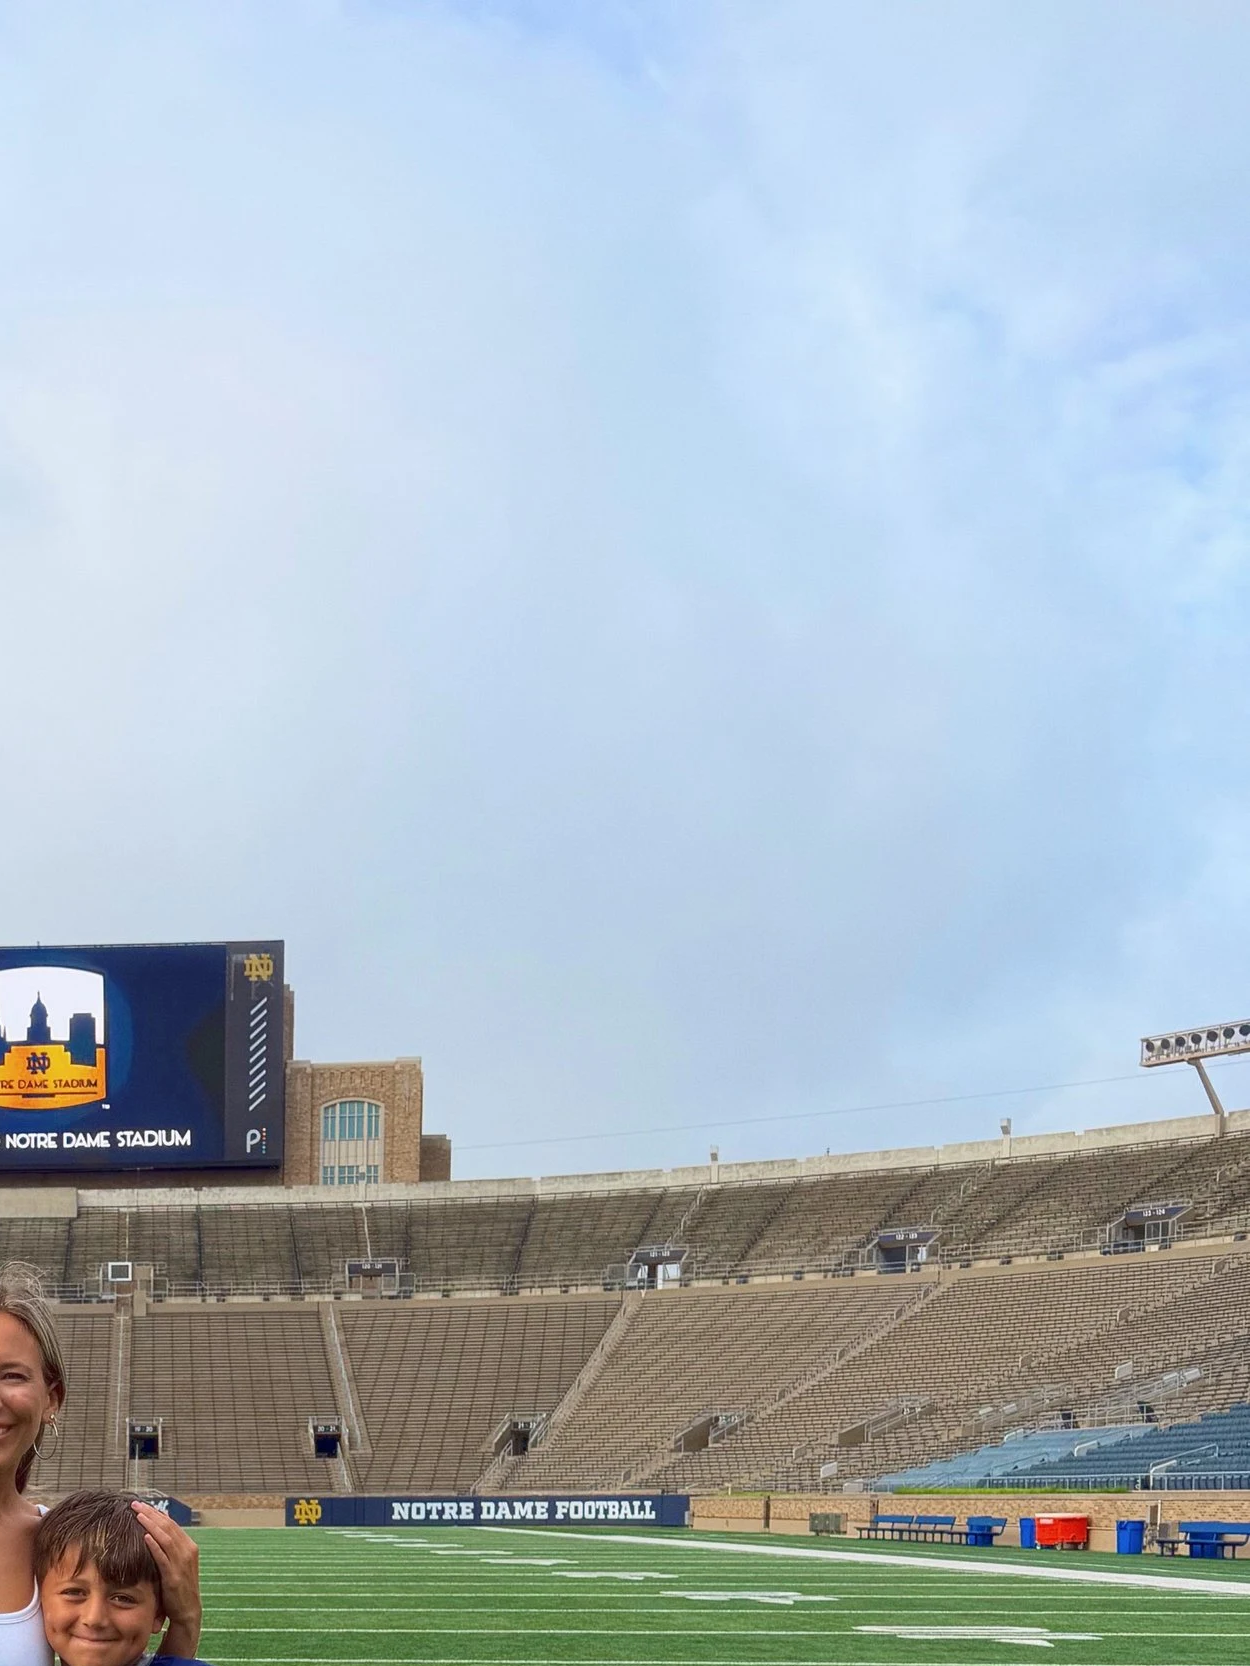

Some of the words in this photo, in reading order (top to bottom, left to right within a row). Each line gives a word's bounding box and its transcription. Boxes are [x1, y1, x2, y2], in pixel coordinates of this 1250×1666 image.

[17, 1079, 49, 1089] DAME
[53, 1078, 98, 1089] STADIUM
[5, 1131, 58, 1149] NOTRE
[62, 1131, 111, 1149] DAME
[116, 1129, 192, 1148] STADIUM
[391, 1502, 475, 1521] NOTRE
[480, 1501, 549, 1520] DAME
[554, 1501, 656, 1520] FOOTBALL
